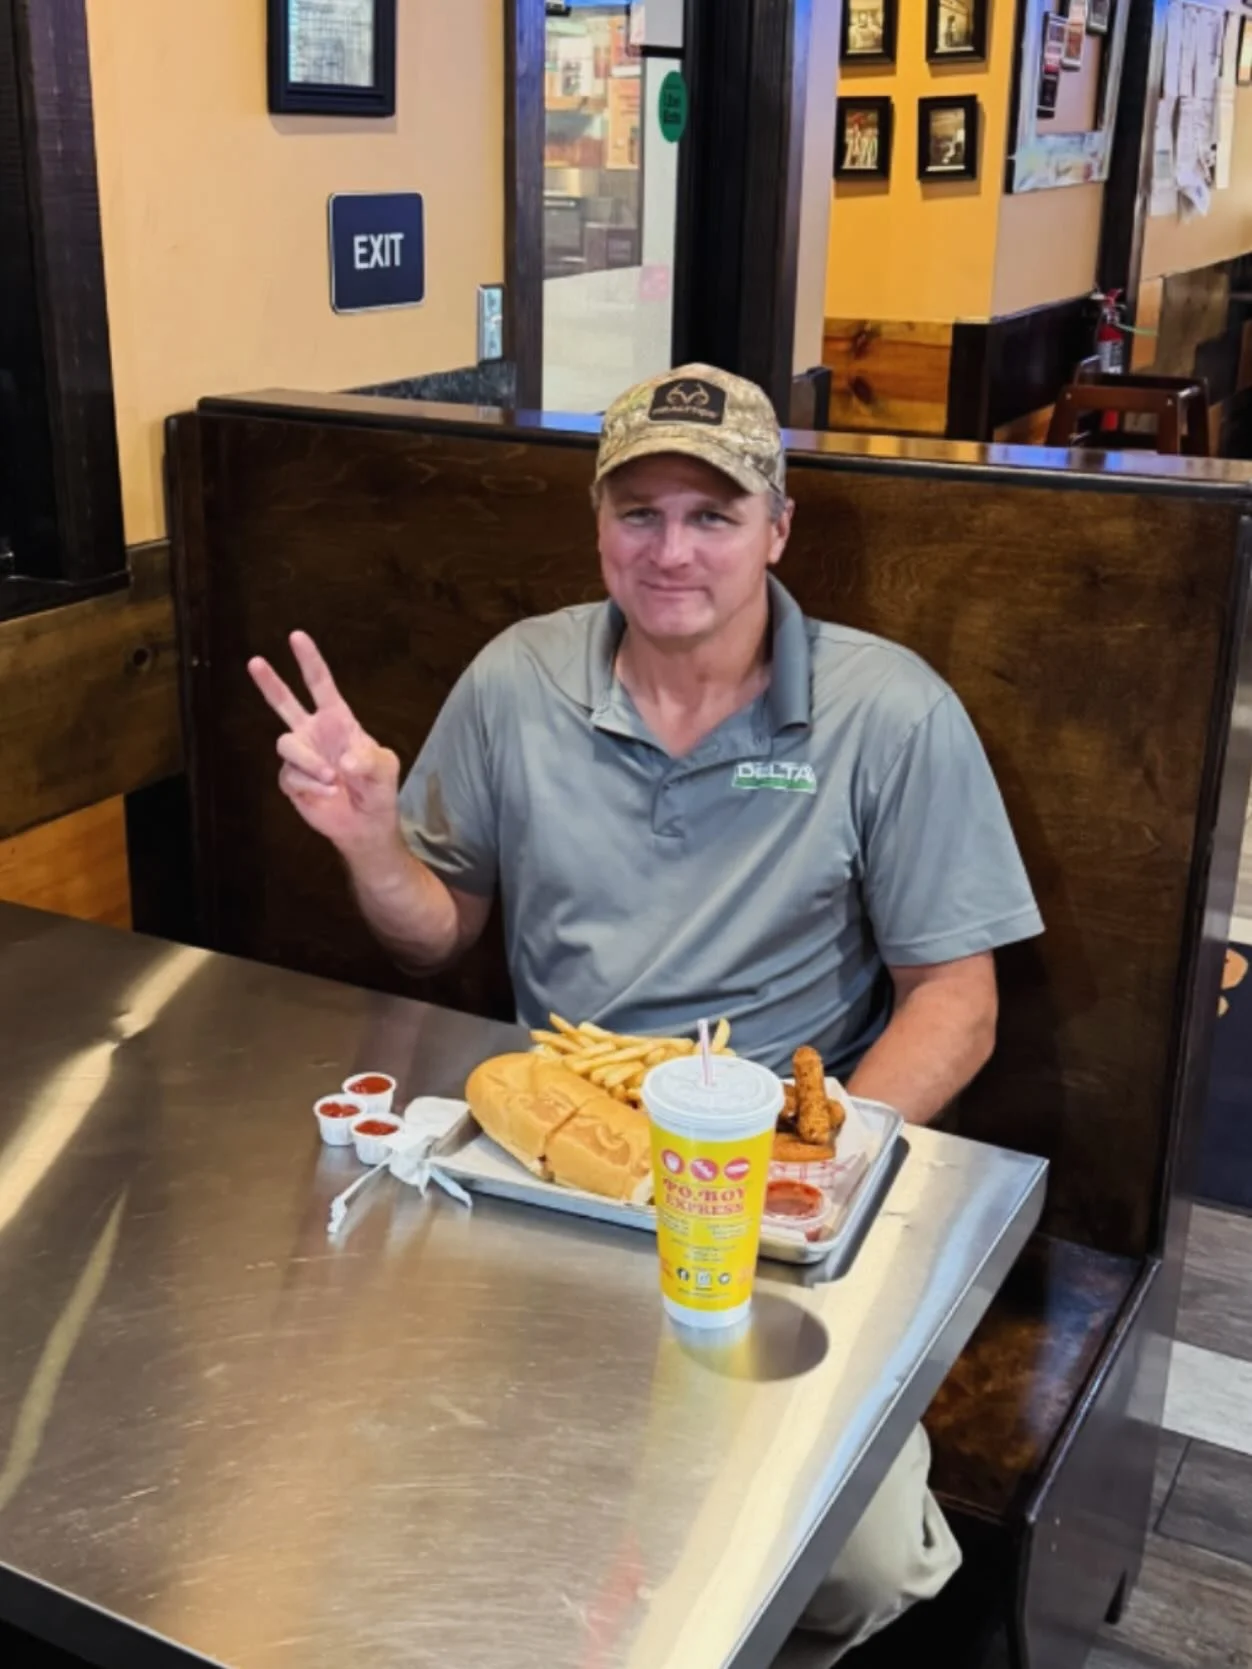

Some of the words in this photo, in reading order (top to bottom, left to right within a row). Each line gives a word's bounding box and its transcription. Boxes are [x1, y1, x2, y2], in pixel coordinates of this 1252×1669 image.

[353, 232, 404, 269] EXIT
[738, 762, 814, 782] DELTA
[666, 1194, 744, 1215] EXPRESS
